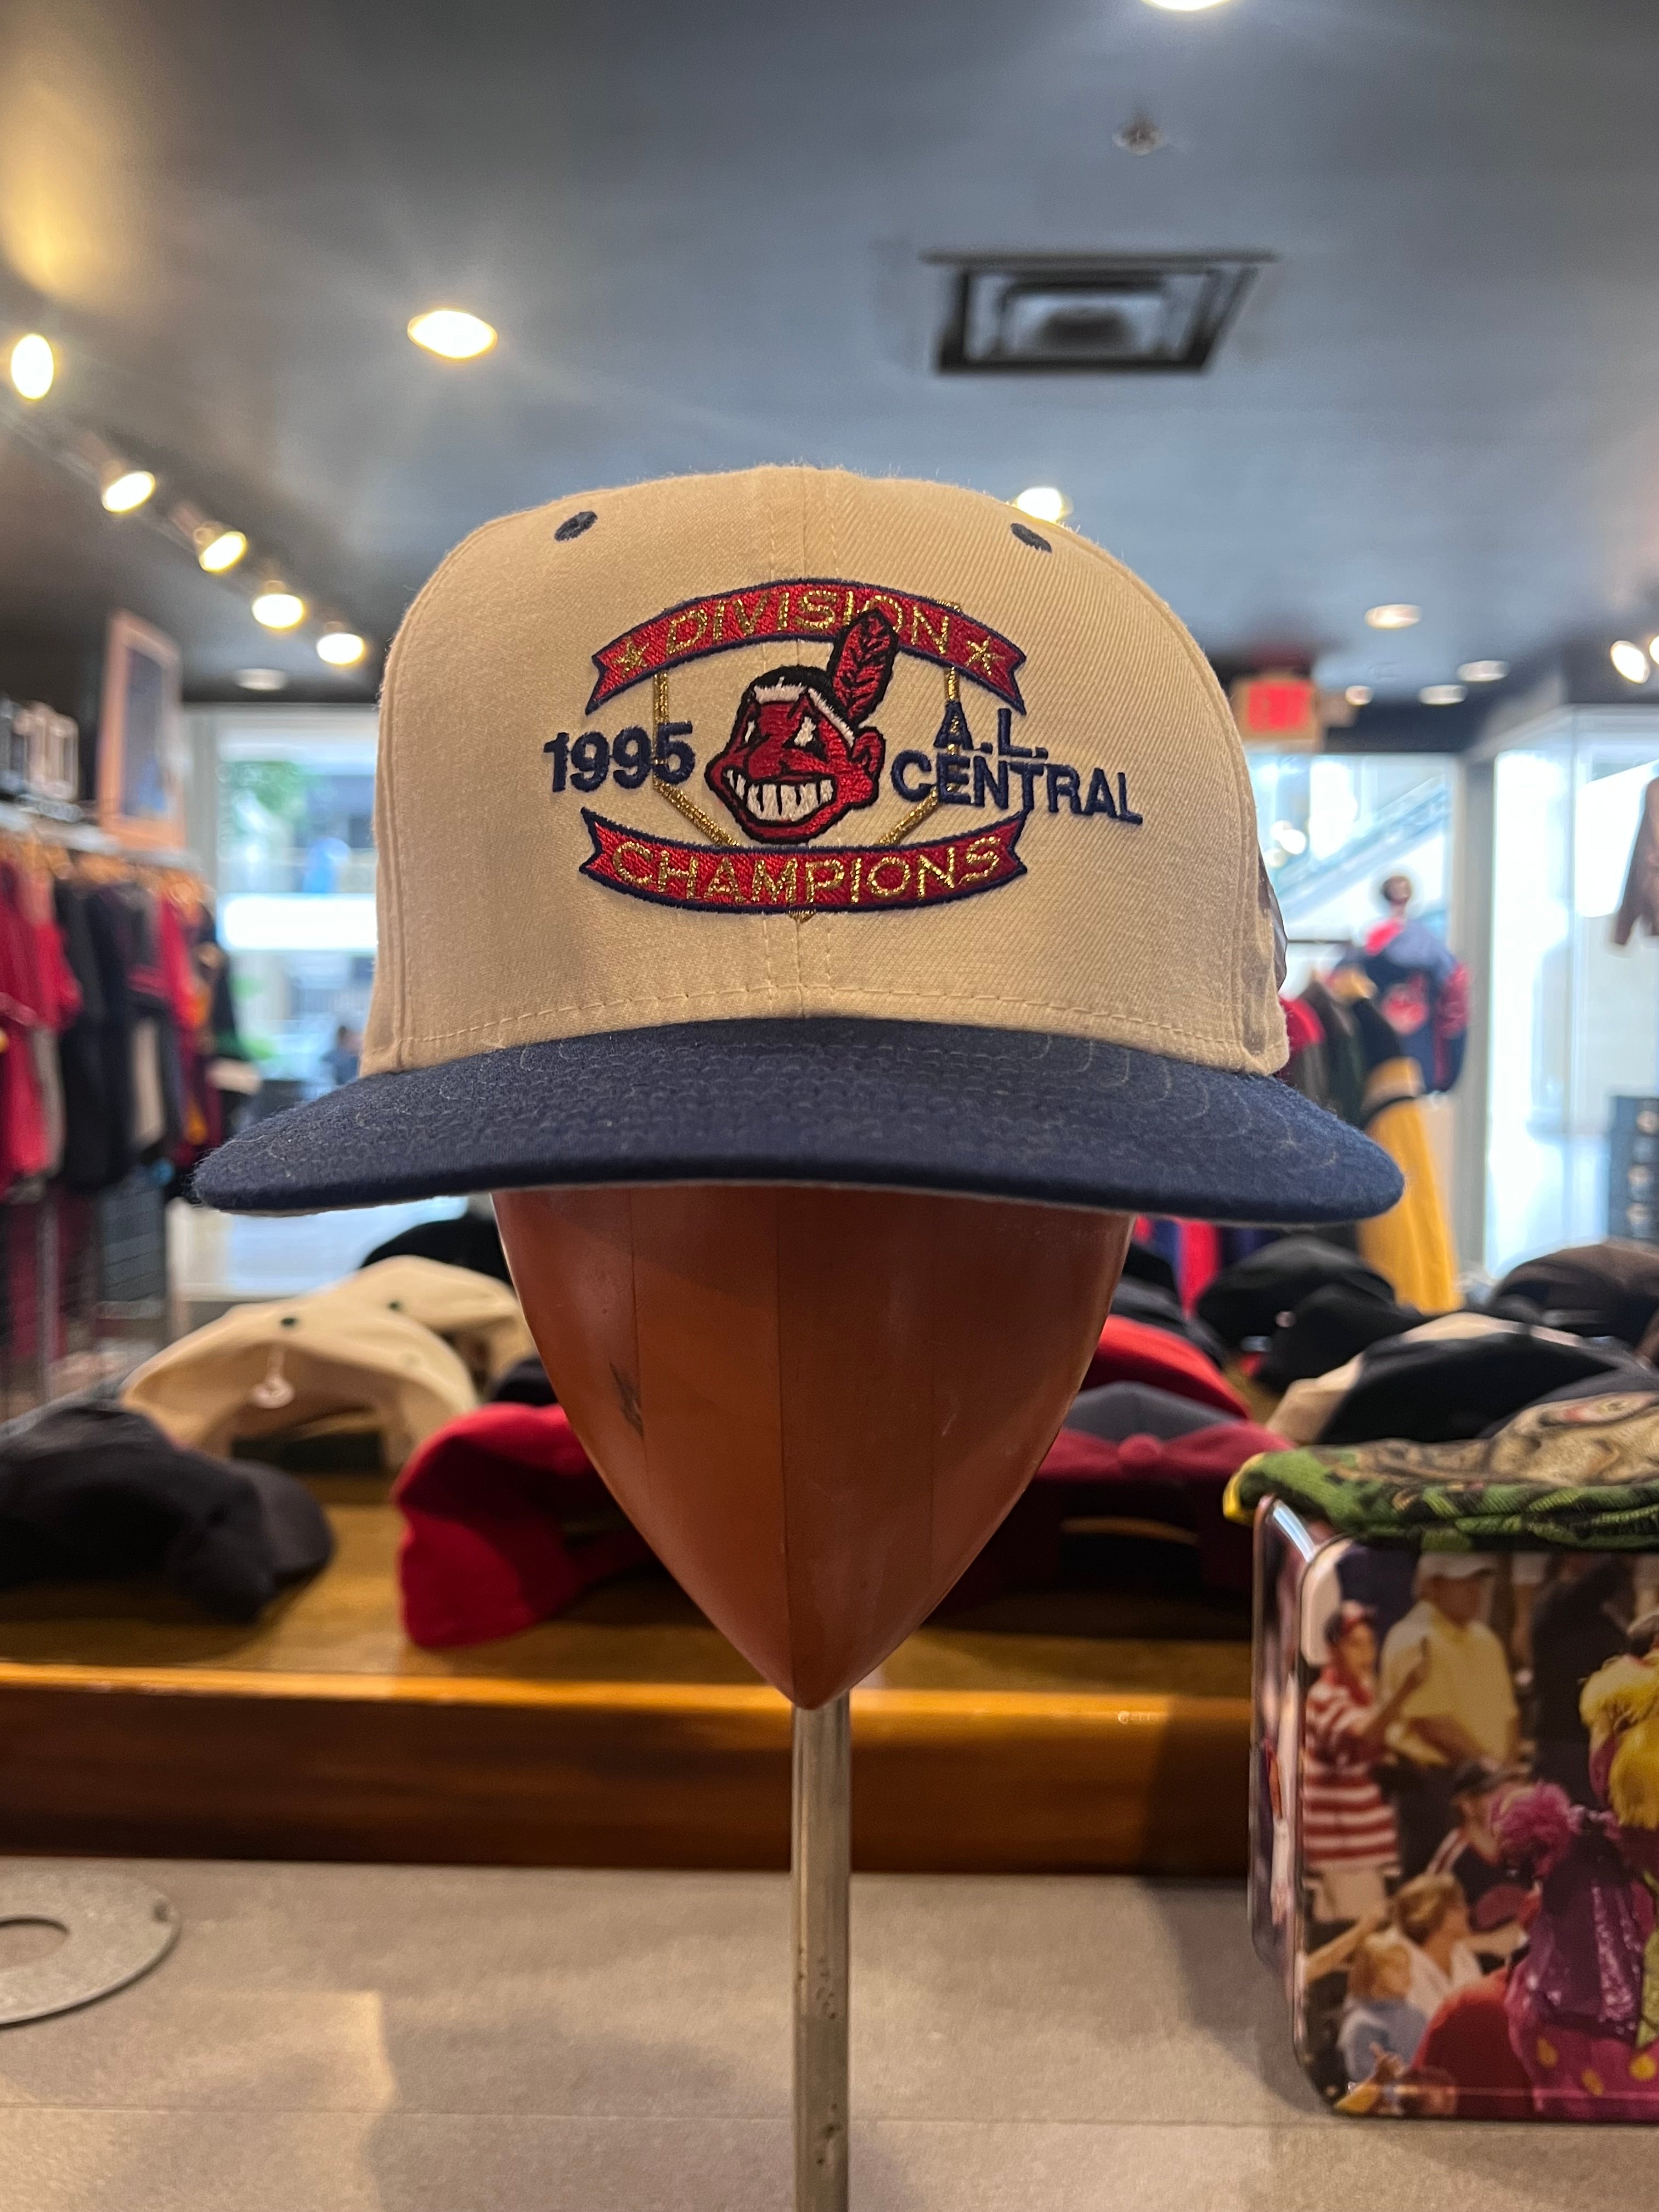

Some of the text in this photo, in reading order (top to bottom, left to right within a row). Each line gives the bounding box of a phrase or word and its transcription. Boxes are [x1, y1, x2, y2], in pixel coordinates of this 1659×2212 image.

[667, 590, 950, 655] DIVISION
[544, 721, 693, 792] 1995
[935, 702, 1048, 757] A.L.
[890, 751, 1143, 825] CENTRAL
[612, 837, 1000, 904] CHAMPIONS
